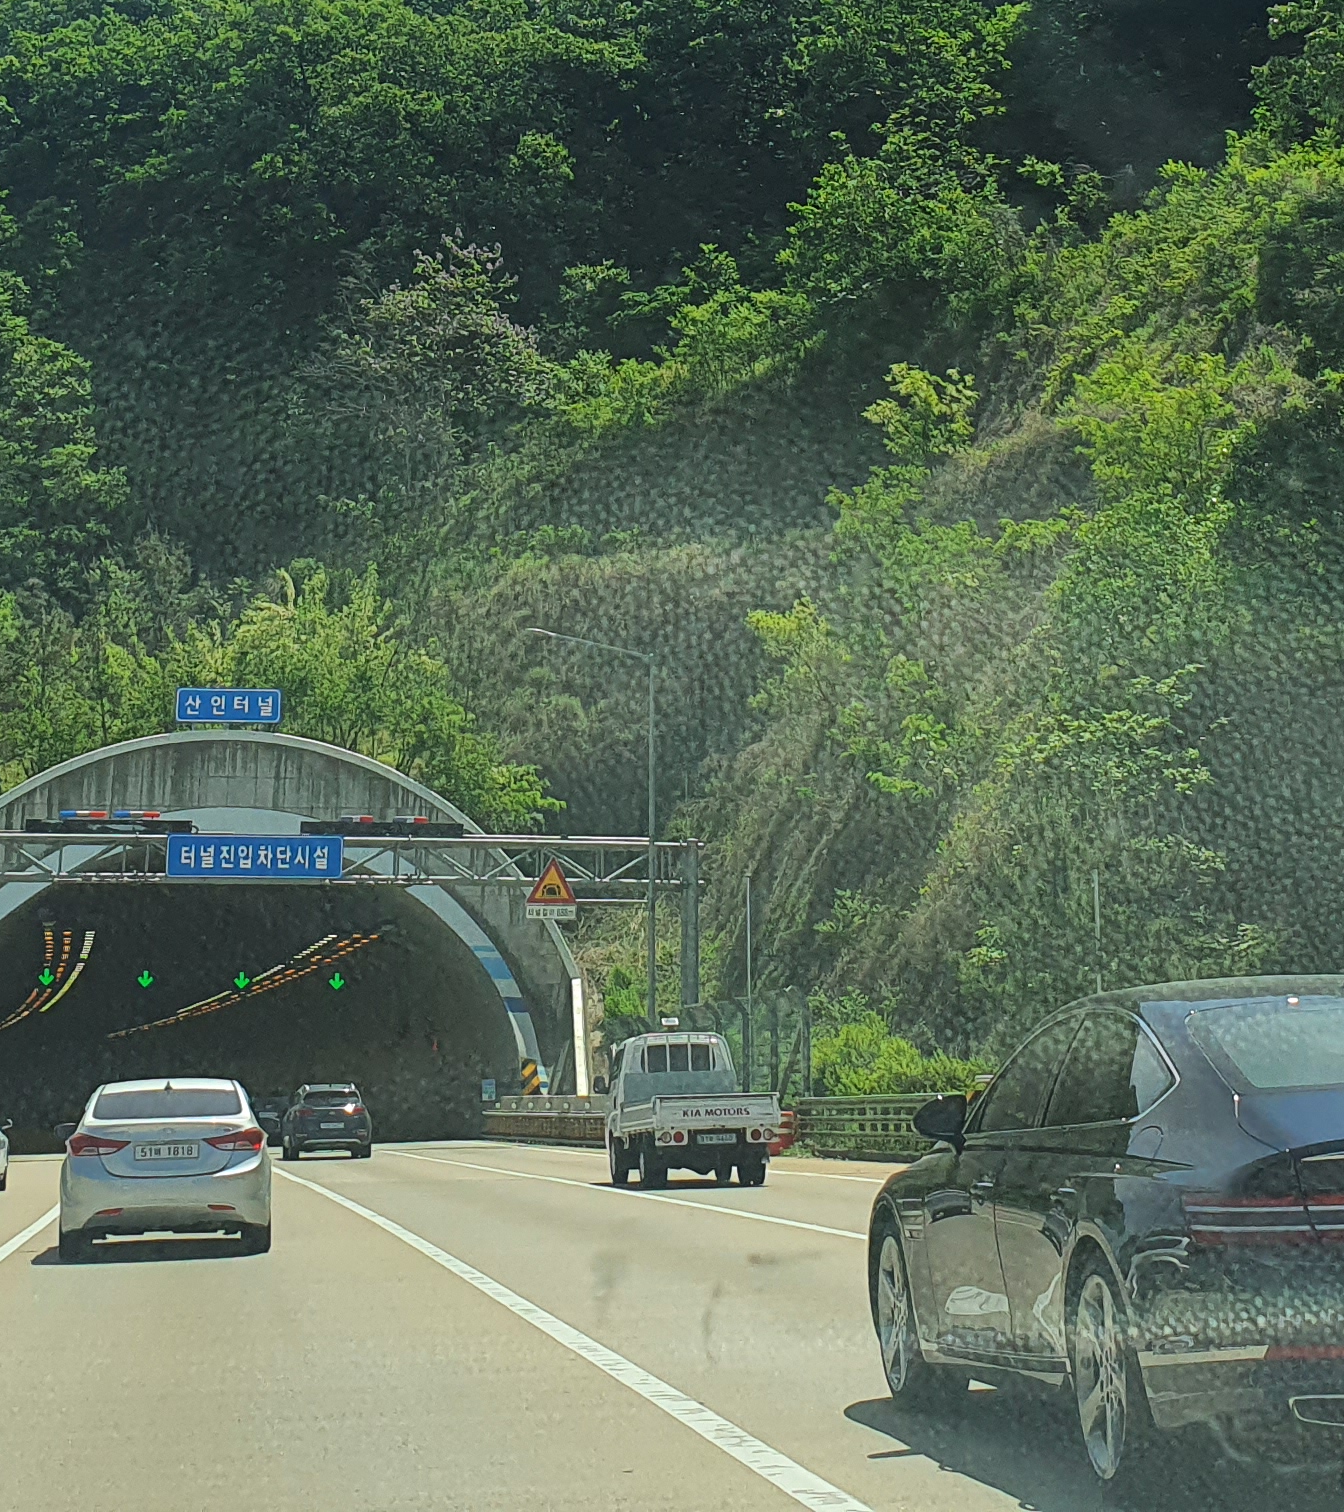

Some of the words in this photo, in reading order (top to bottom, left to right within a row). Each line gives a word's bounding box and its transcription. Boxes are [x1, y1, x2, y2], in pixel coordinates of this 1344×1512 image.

[184, 694, 273, 717] 산인터널
[180, 844, 329, 870] 터널진입차단시설
[682, 1108, 701, 1118] KIA
[704, 1107, 751, 1117] MOTORS
